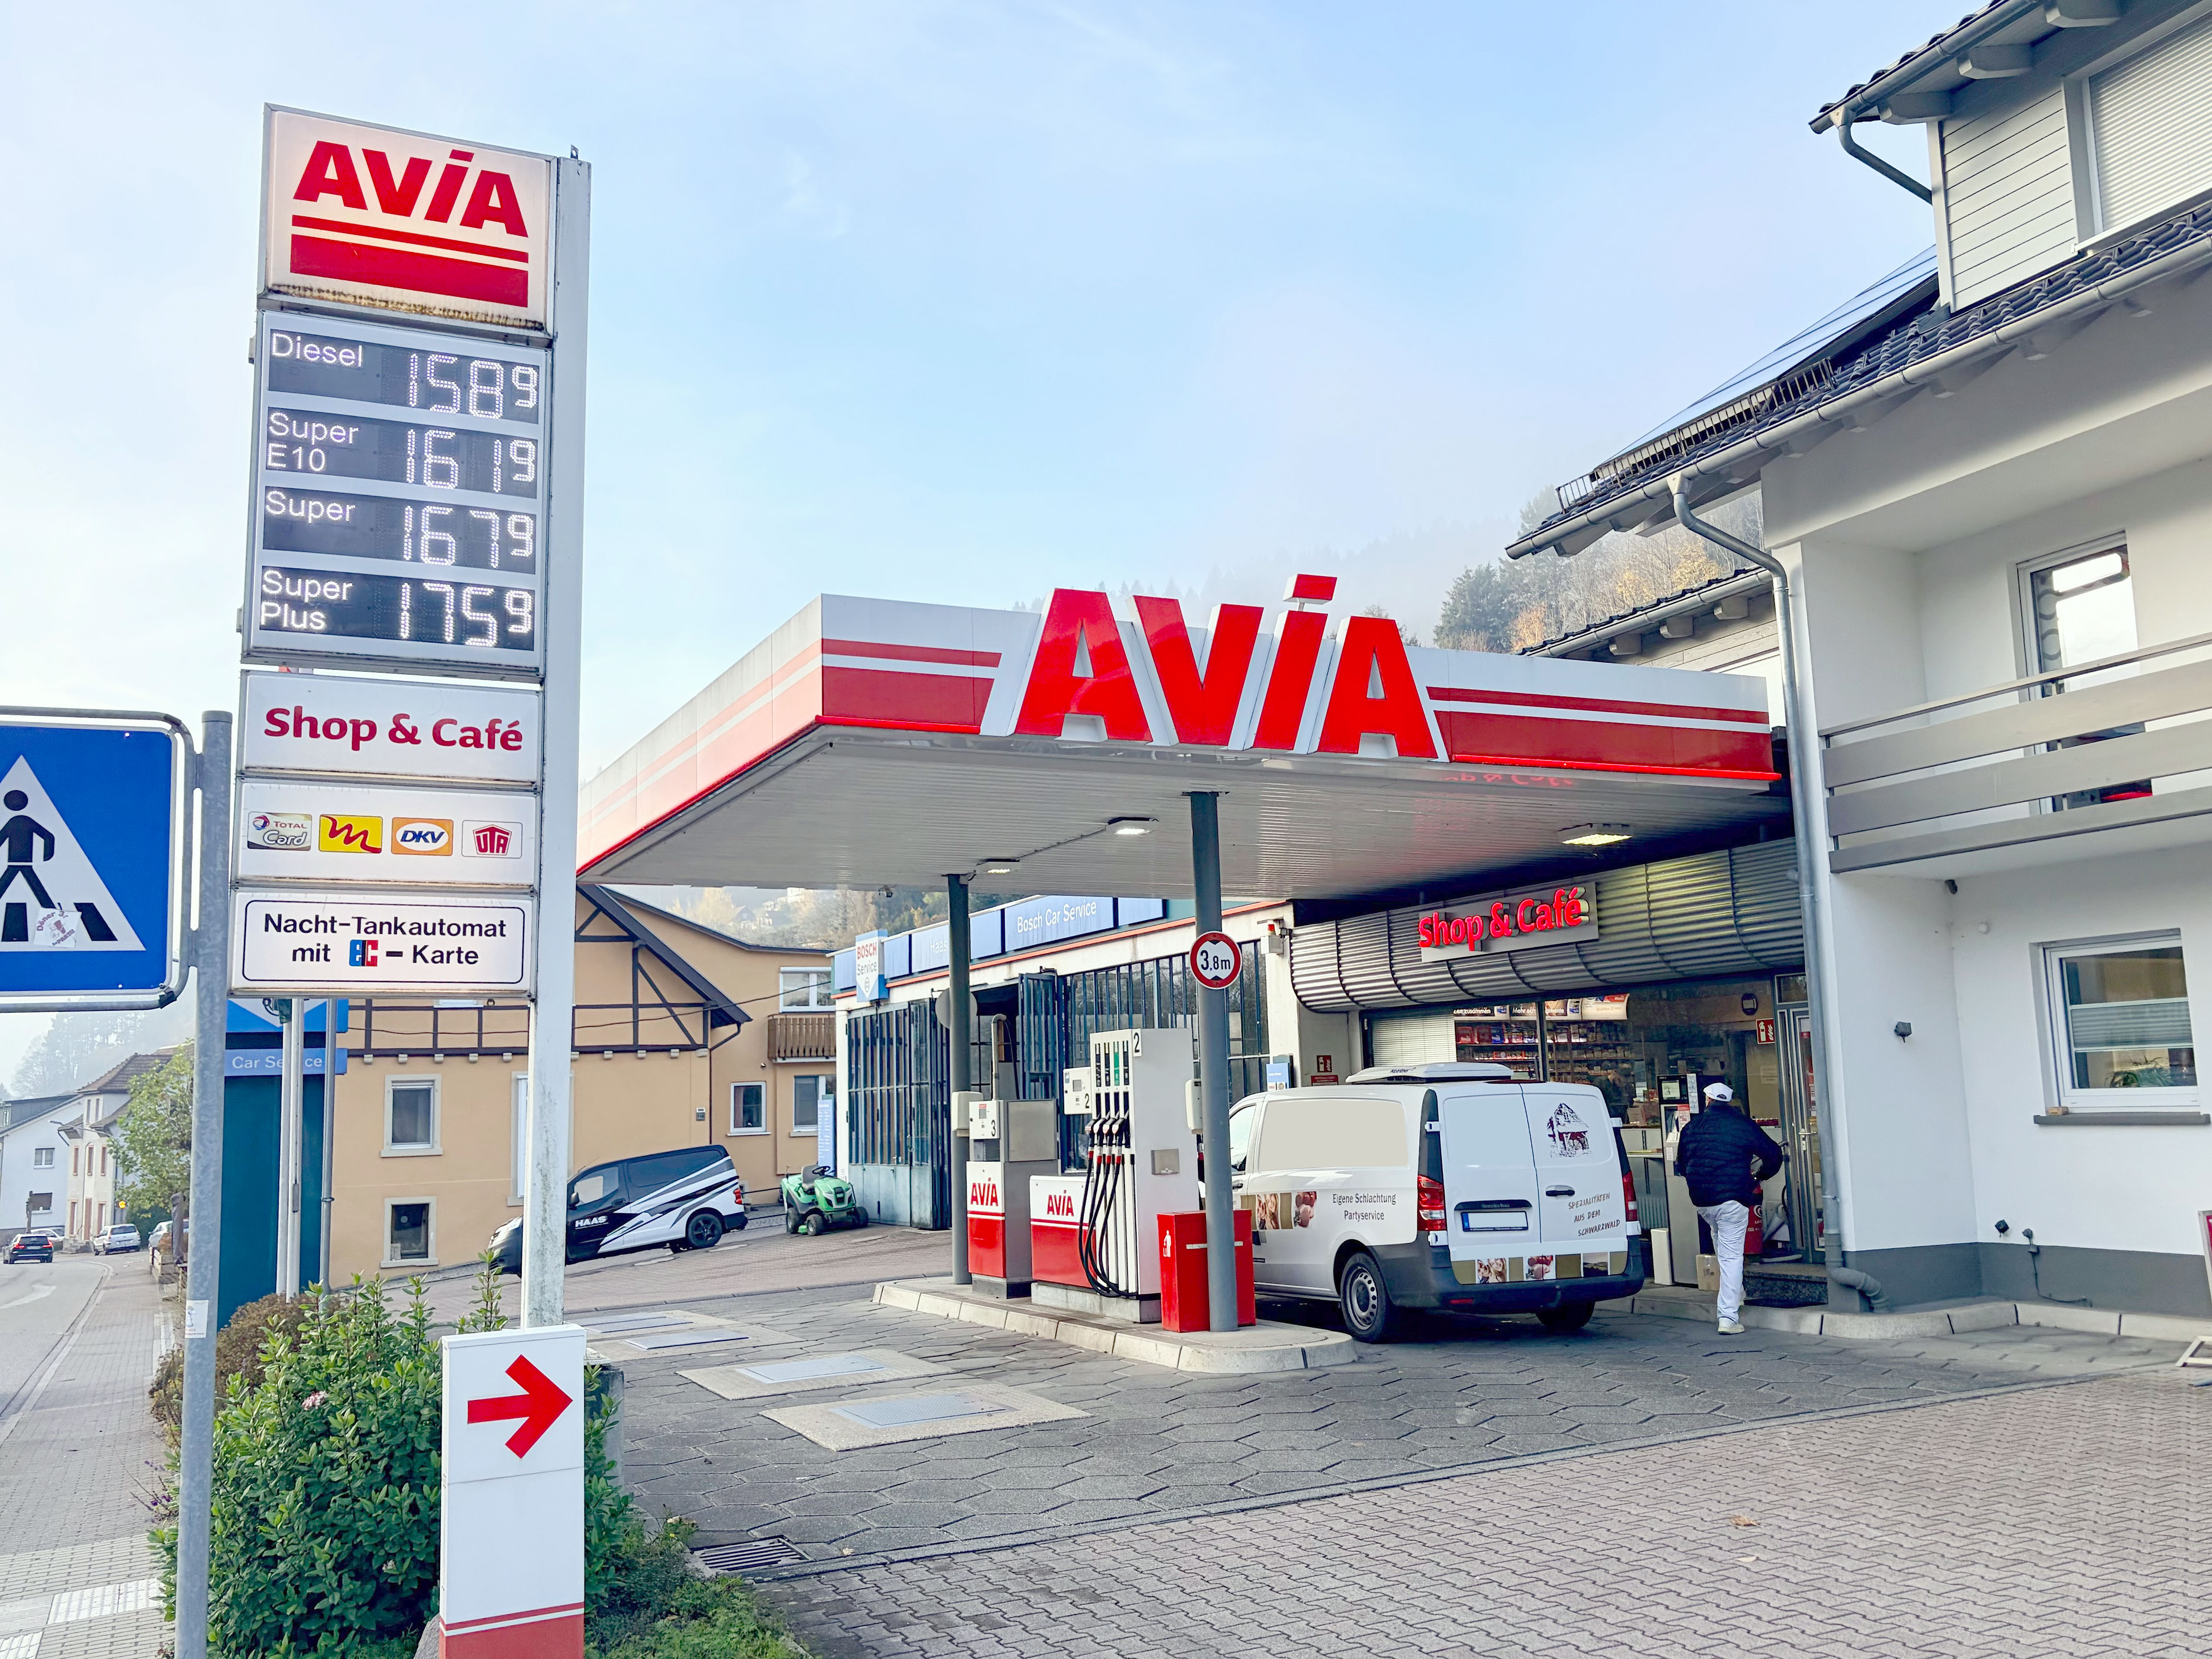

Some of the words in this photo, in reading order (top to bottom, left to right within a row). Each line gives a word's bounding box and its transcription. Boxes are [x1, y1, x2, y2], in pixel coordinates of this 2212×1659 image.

[293, 141, 528, 238] AVIA
[271, 333, 363, 367] Diesel
[268, 412, 359, 445] Super
[267, 443, 326, 472] E10
[265, 491, 356, 524] Super
[262, 569, 353, 602] Super
[261, 602, 326, 630] Plus
[1013, 573, 1438, 759] AVIA
[264, 706, 377, 751] Shop
[389, 713, 422, 745] &
[432, 718, 523, 751] Café
[263, 830, 307, 846] Card
[400, 830, 444, 843] DKV
[475, 826, 510, 854] UTA
[36, 912, 56, 931] Döner
[264, 913, 506, 937] Nacht-Tankautomat
[1017, 911, 1042, 933] Bosch
[1046, 908, 1061, 926] Car
[1063, 899, 1097, 922] Service
[1418, 911, 1483, 951] Shop
[1490, 901, 1513, 938] &
[1517, 886, 1582, 933] Café
[292, 943, 330, 962] mit
[412, 945, 479, 965] Karte
[857, 942, 877, 960] BOSCH
[929, 940, 948, 953] Haas
[857, 961, 877, 976] Service
[1133, 1032, 1140, 1053] 2
[232, 1056, 260, 1069] Car
[265, 1056, 323, 1068] Sece
[1085, 1093, 1090, 1109] 2
[991, 1119, 996, 1137] 3
[970, 1177, 999, 1207] AVIA
[1333, 1194, 1353, 1205] Eigene
[1355, 1193, 1396, 1205] Schlachtung
[1568, 1192, 1610, 1210] SPEZIALITÄTEN
[1047, 1189, 1074, 1217] AVIA
[575, 1215, 608, 1227] HAAS
[1344, 1210, 1385, 1222] Partyservice
[1574, 1213, 1585, 1223] AUS
[1588, 1209, 1601, 1220] DEM
[1578, 1219, 1621, 1237] SCHWARZWALD
